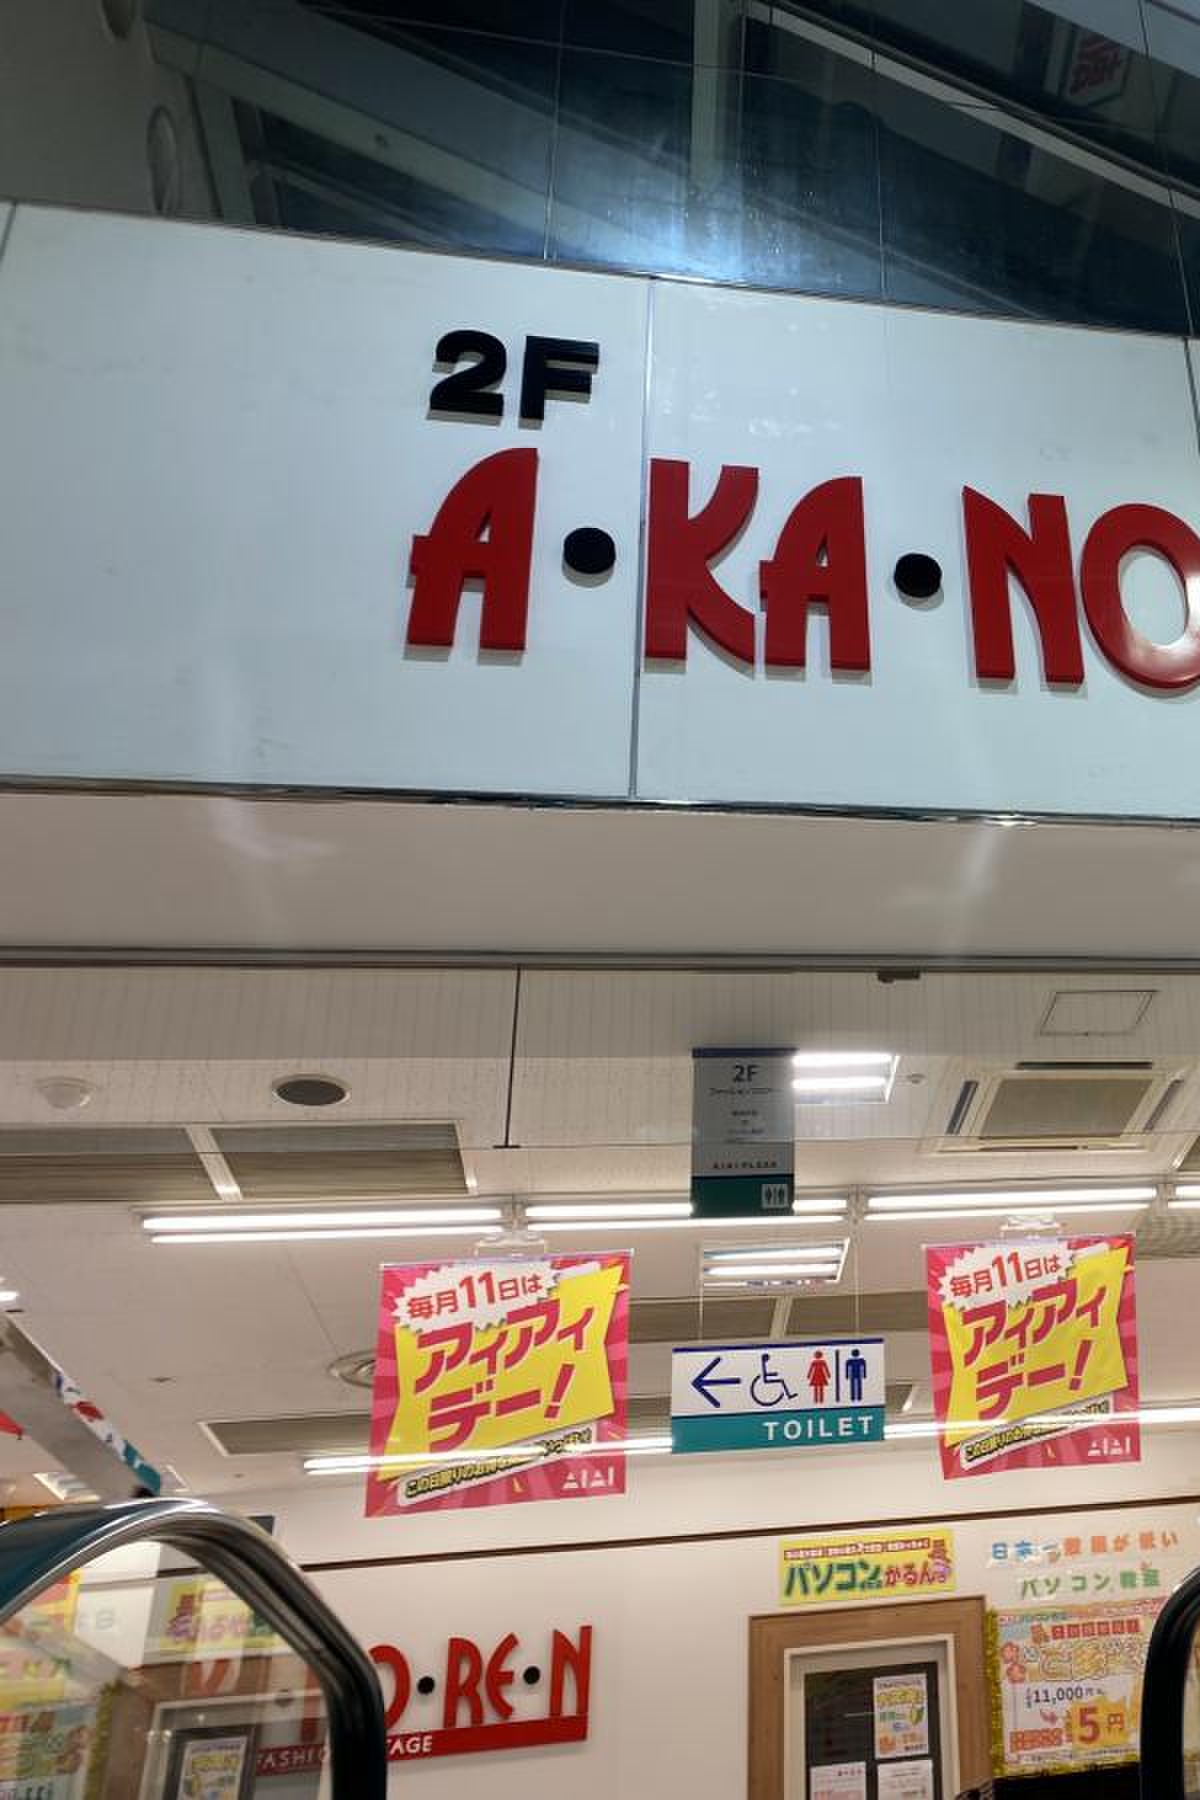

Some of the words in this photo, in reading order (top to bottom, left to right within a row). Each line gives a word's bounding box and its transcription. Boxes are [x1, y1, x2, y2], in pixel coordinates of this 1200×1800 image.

[428, 329, 600, 424] 2F
[732, 1064, 759, 1083] 2F
[407, 1271, 543, 1320] 毎月11日は
[950, 1252, 1062, 1298] 毎月11日は
[763, 1415, 874, 1441] TOILET
